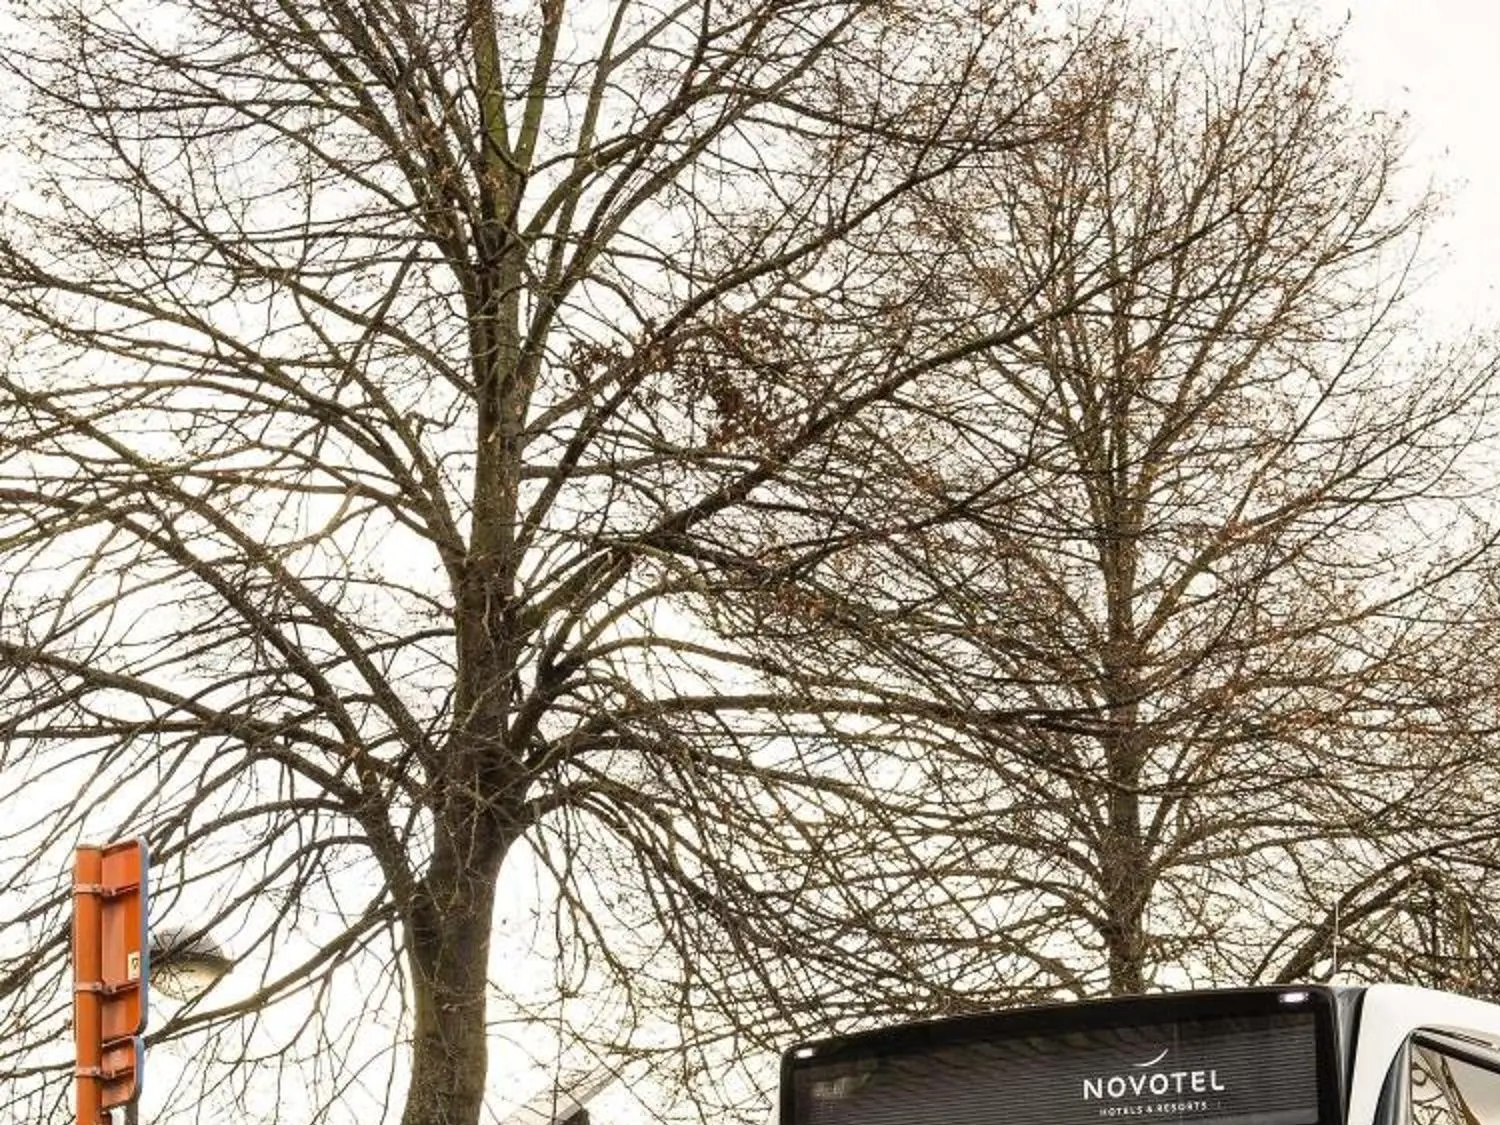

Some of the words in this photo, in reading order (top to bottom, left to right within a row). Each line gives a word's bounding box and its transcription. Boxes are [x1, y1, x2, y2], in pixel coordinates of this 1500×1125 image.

[1083, 1069, 1225, 1100] NOVOTEL
[1100, 1106, 1143, 1117] HOTELS
[1146, 1104, 1154, 1114] &
[1156, 1102, 1208, 1114] RESORTS
